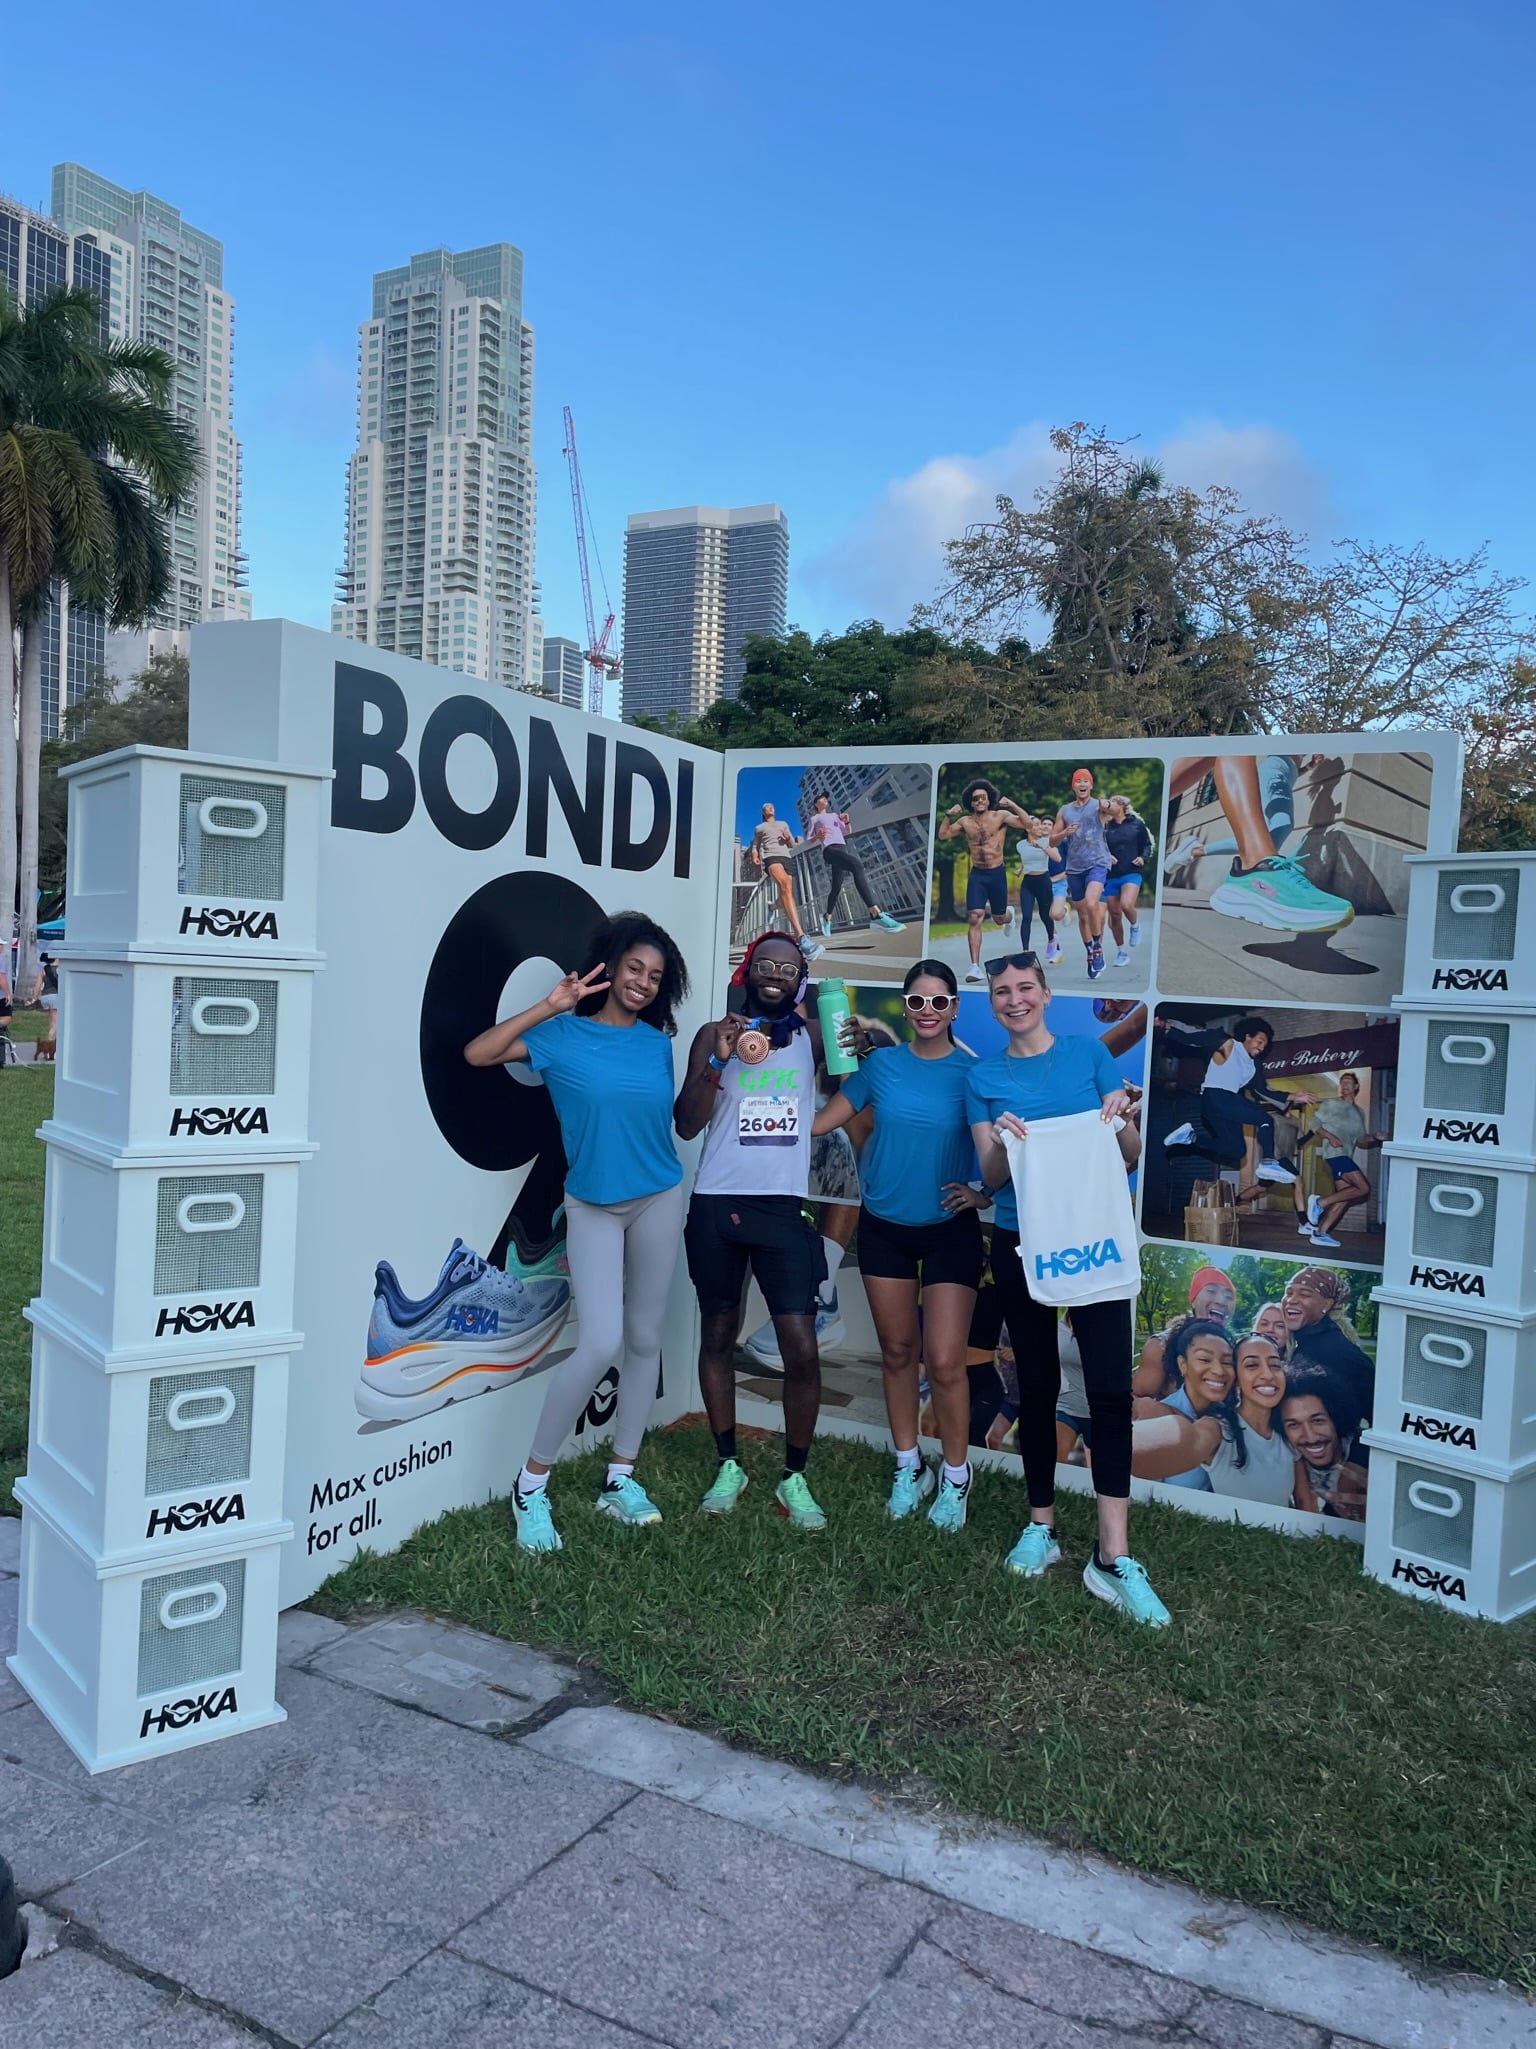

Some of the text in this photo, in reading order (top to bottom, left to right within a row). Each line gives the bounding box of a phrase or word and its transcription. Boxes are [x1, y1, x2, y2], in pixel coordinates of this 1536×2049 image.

[331, 660, 694, 879] BONDI
[179, 906, 278, 940] HOKA
[1431, 968, 1509, 991] HOKA
[1291, 1047, 1363, 1066] Bakery
[170, 1107, 269, 1137] HOKA
[740, 1117, 797, 1132] 26047
[1423, 1118, 1500, 1146] HOKA
[1035, 1238, 1121, 1280] HOKA
[1410, 1265, 1486, 1298] HOKA
[155, 1300, 255, 1337] HOKA
[444, 1304, 499, 1335] HOKA
[1401, 1412, 1478, 1451] HOKA
[309, 1440, 452, 1513] Max cushion
[146, 1493, 245, 1538] HOKA
[307, 1497, 382, 1556] for all.
[1391, 1558, 1467, 1602] HOKA
[139, 1687, 238, 1738] HOKA
